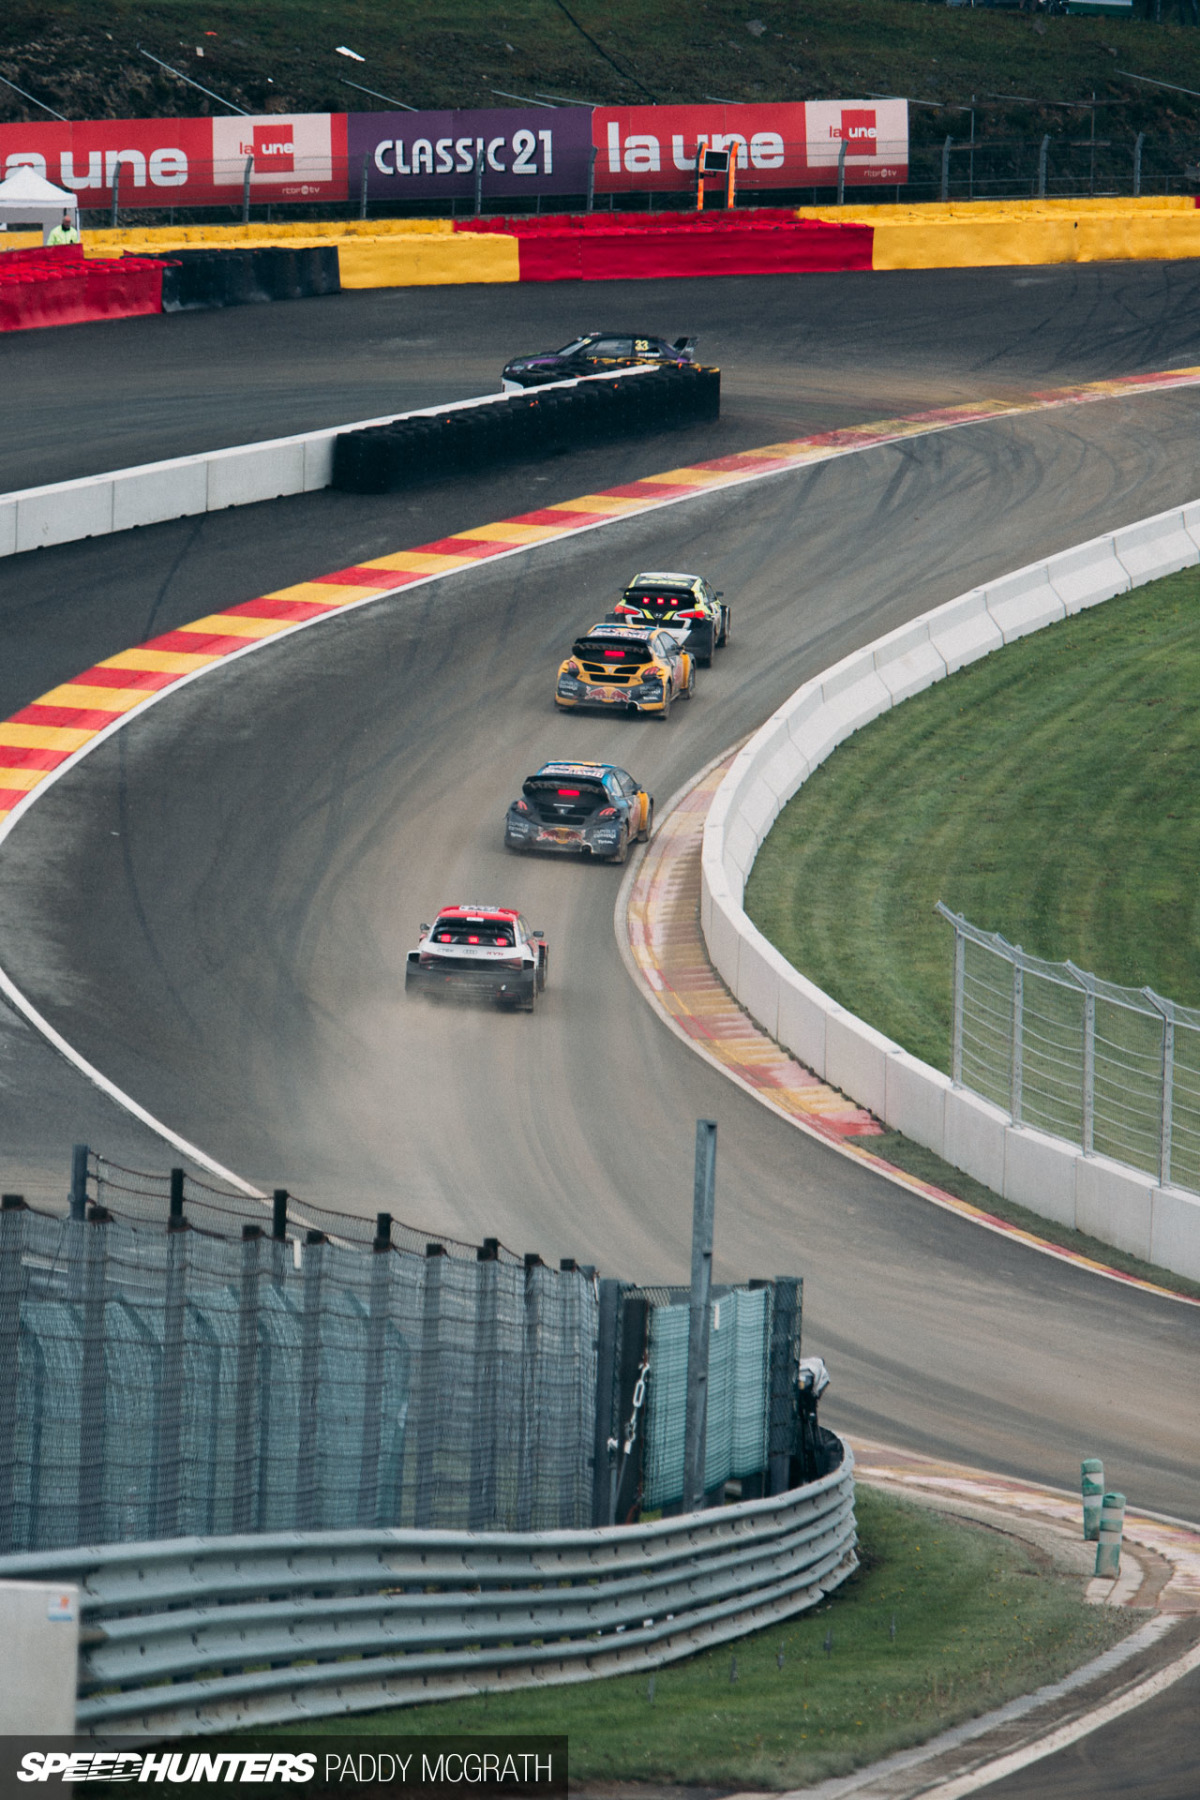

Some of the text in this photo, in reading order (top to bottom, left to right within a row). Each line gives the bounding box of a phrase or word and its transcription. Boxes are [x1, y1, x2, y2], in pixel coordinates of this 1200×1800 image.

[829, 126, 877, 139] la une
[240, 142, 295, 155] la une
[374, 129, 553, 175] CLASSIC 21
[607, 121, 785, 172] la une
[60, 148, 189, 190] une
[635, 339, 649, 351] 33
